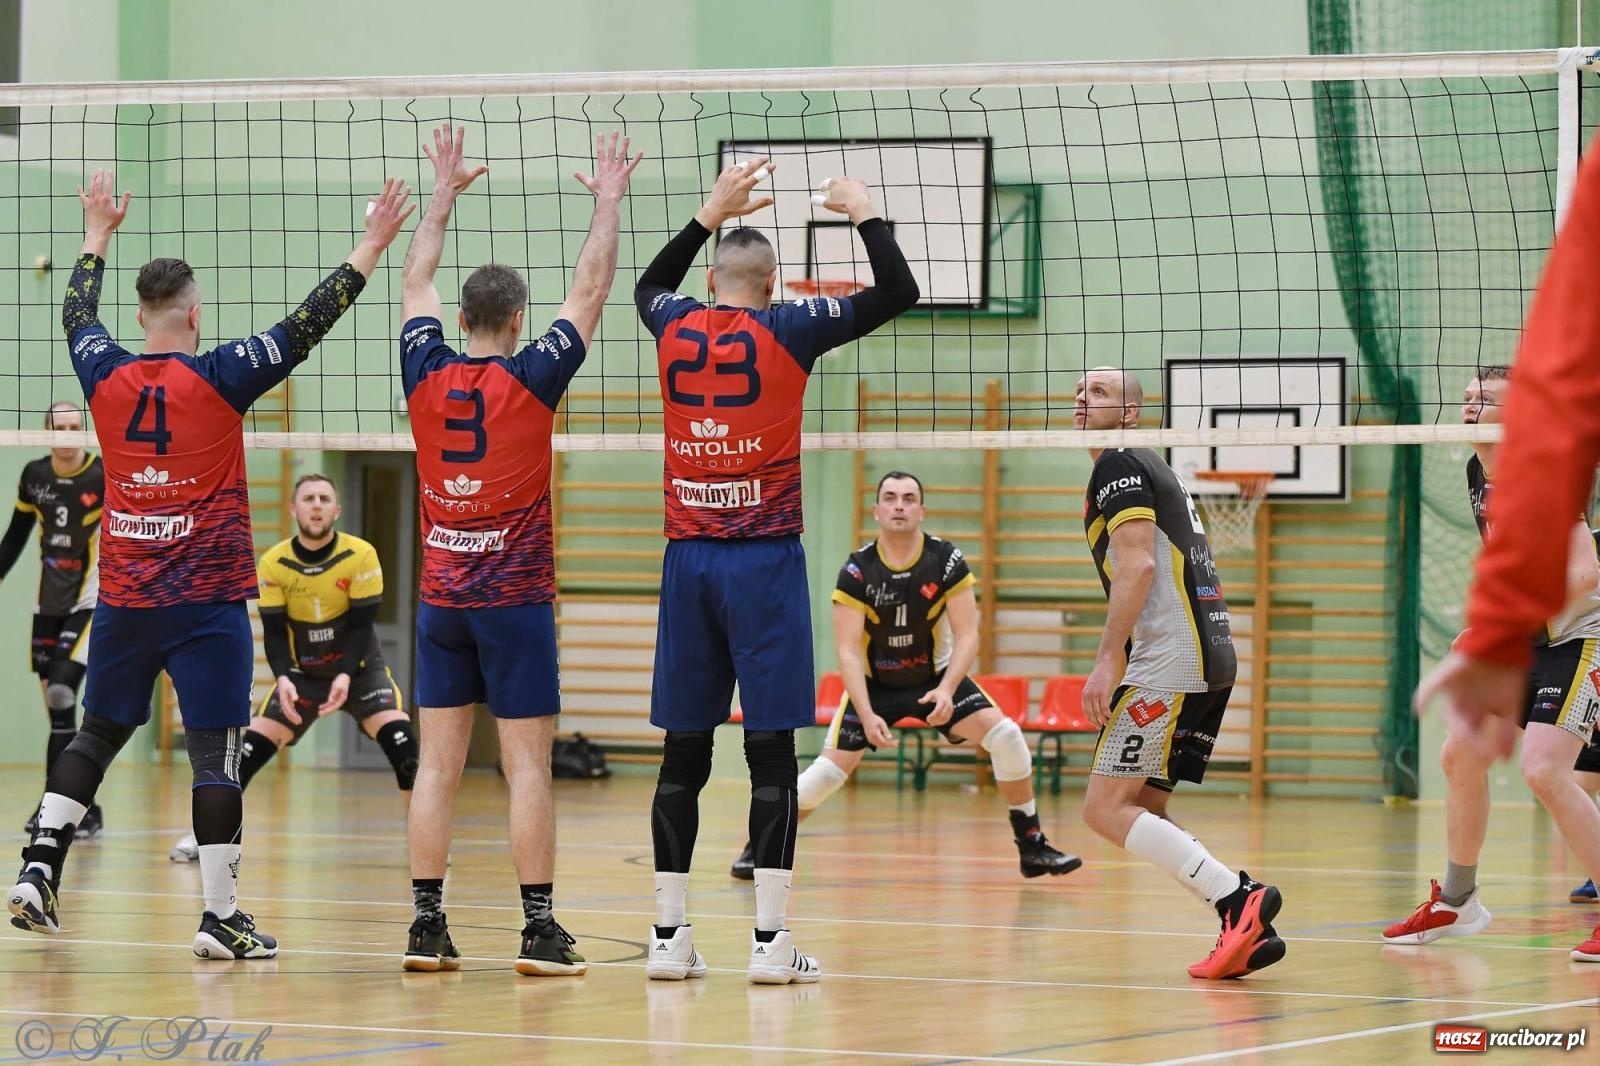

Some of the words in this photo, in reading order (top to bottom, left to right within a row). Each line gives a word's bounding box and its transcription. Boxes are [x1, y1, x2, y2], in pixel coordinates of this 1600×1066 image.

[667, 327, 762, 408] 23
[125, 385, 172, 455] 4
[441, 388, 488, 464] 3
[670, 436, 763, 457] KATOLIK
[55, 506, 69, 528] 3
[110, 515, 190, 540] nowiny.pl
[894, 604, 908, 627] 11
[1119, 734, 1145, 764] 2
